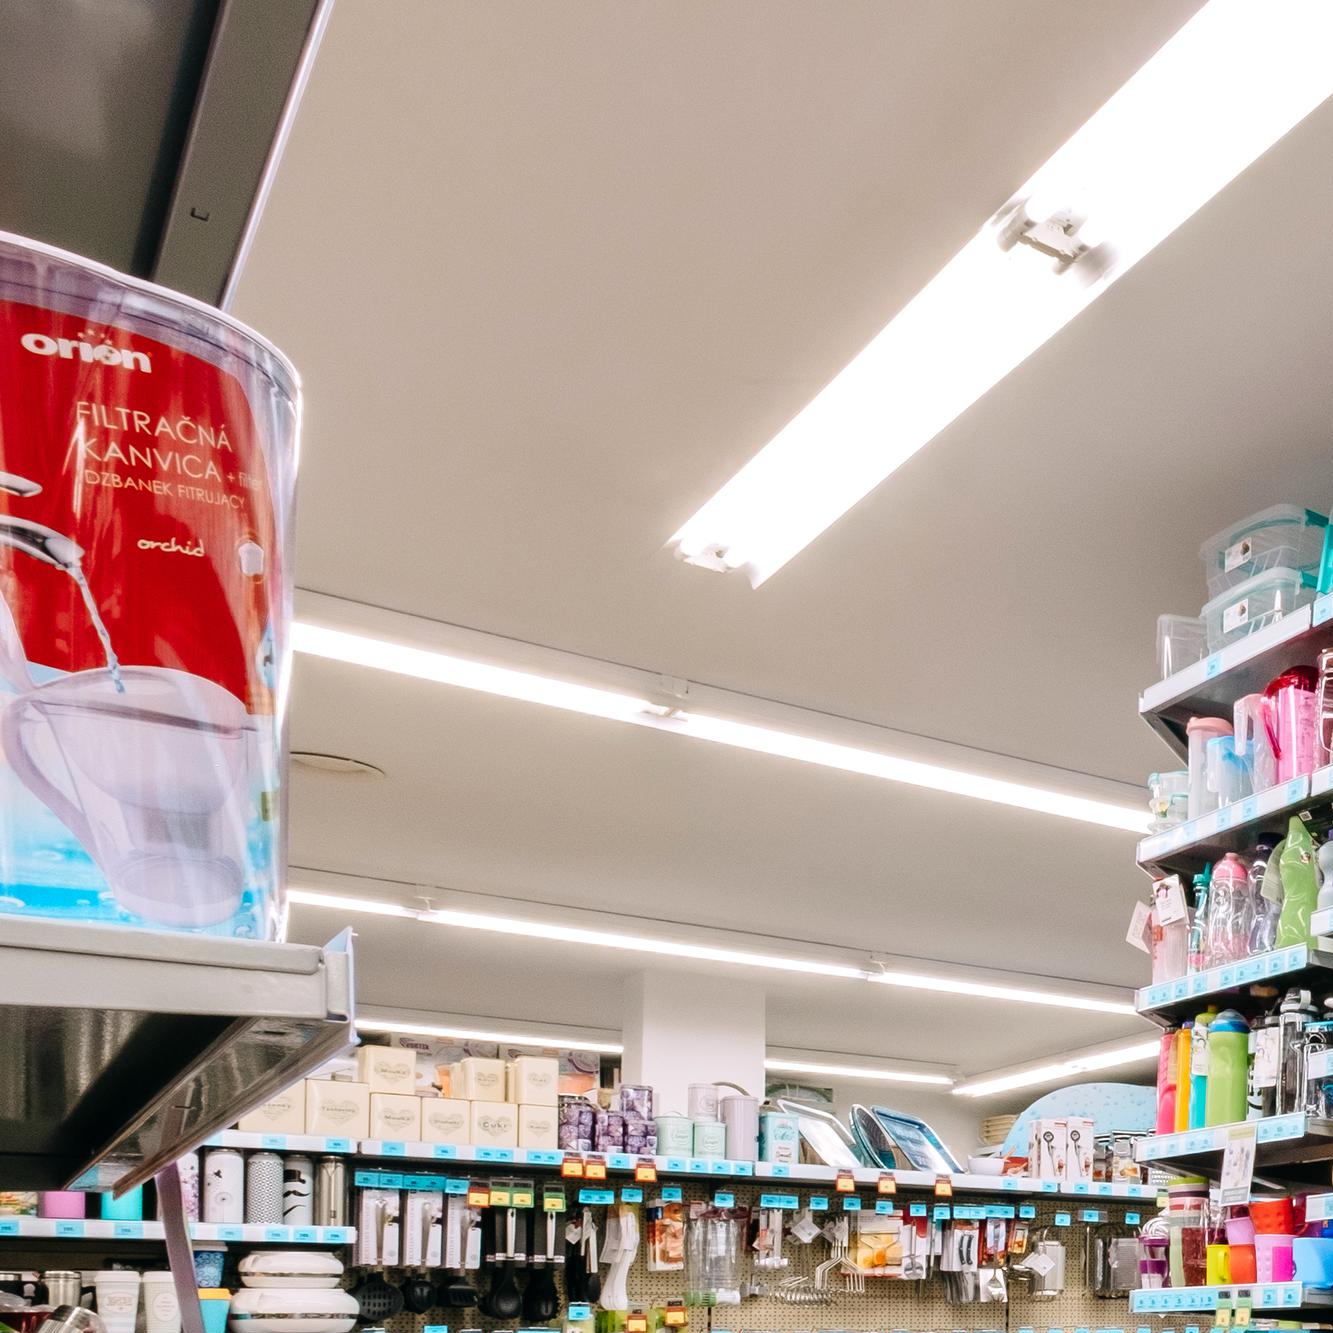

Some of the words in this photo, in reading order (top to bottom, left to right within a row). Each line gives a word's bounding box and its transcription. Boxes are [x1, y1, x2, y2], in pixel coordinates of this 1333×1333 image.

[21, 332, 152, 373] orion
[76, 401, 232, 452] FILTRAČNÁ
[82, 438, 222, 481] KANVICA
[84, 469, 173, 496] DZBANEK
[138, 538, 205, 557] orchid
